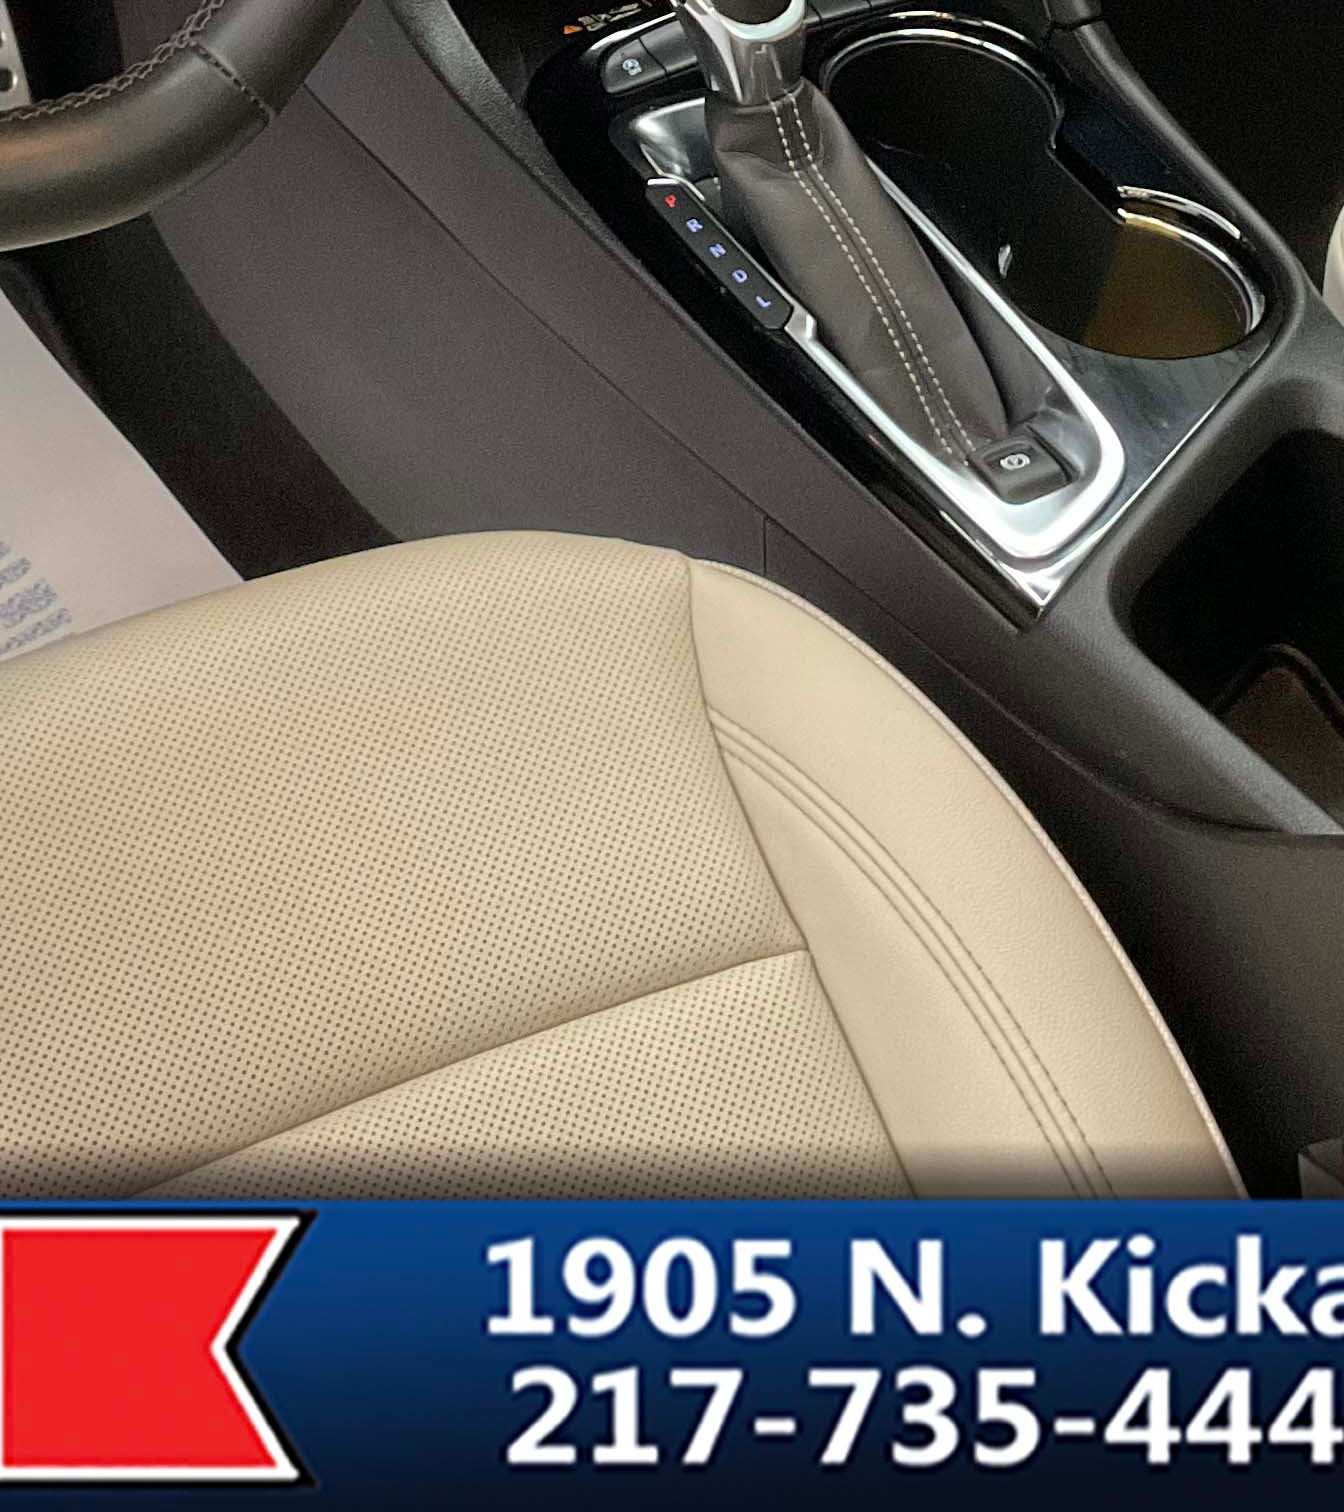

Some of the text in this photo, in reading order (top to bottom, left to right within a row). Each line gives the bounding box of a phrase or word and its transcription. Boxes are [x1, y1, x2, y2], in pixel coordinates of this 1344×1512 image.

[686, 218, 703, 233] R
[709, 243, 726, 258] N
[731, 269, 748, 283] D
[756, 295, 771, 308] L
